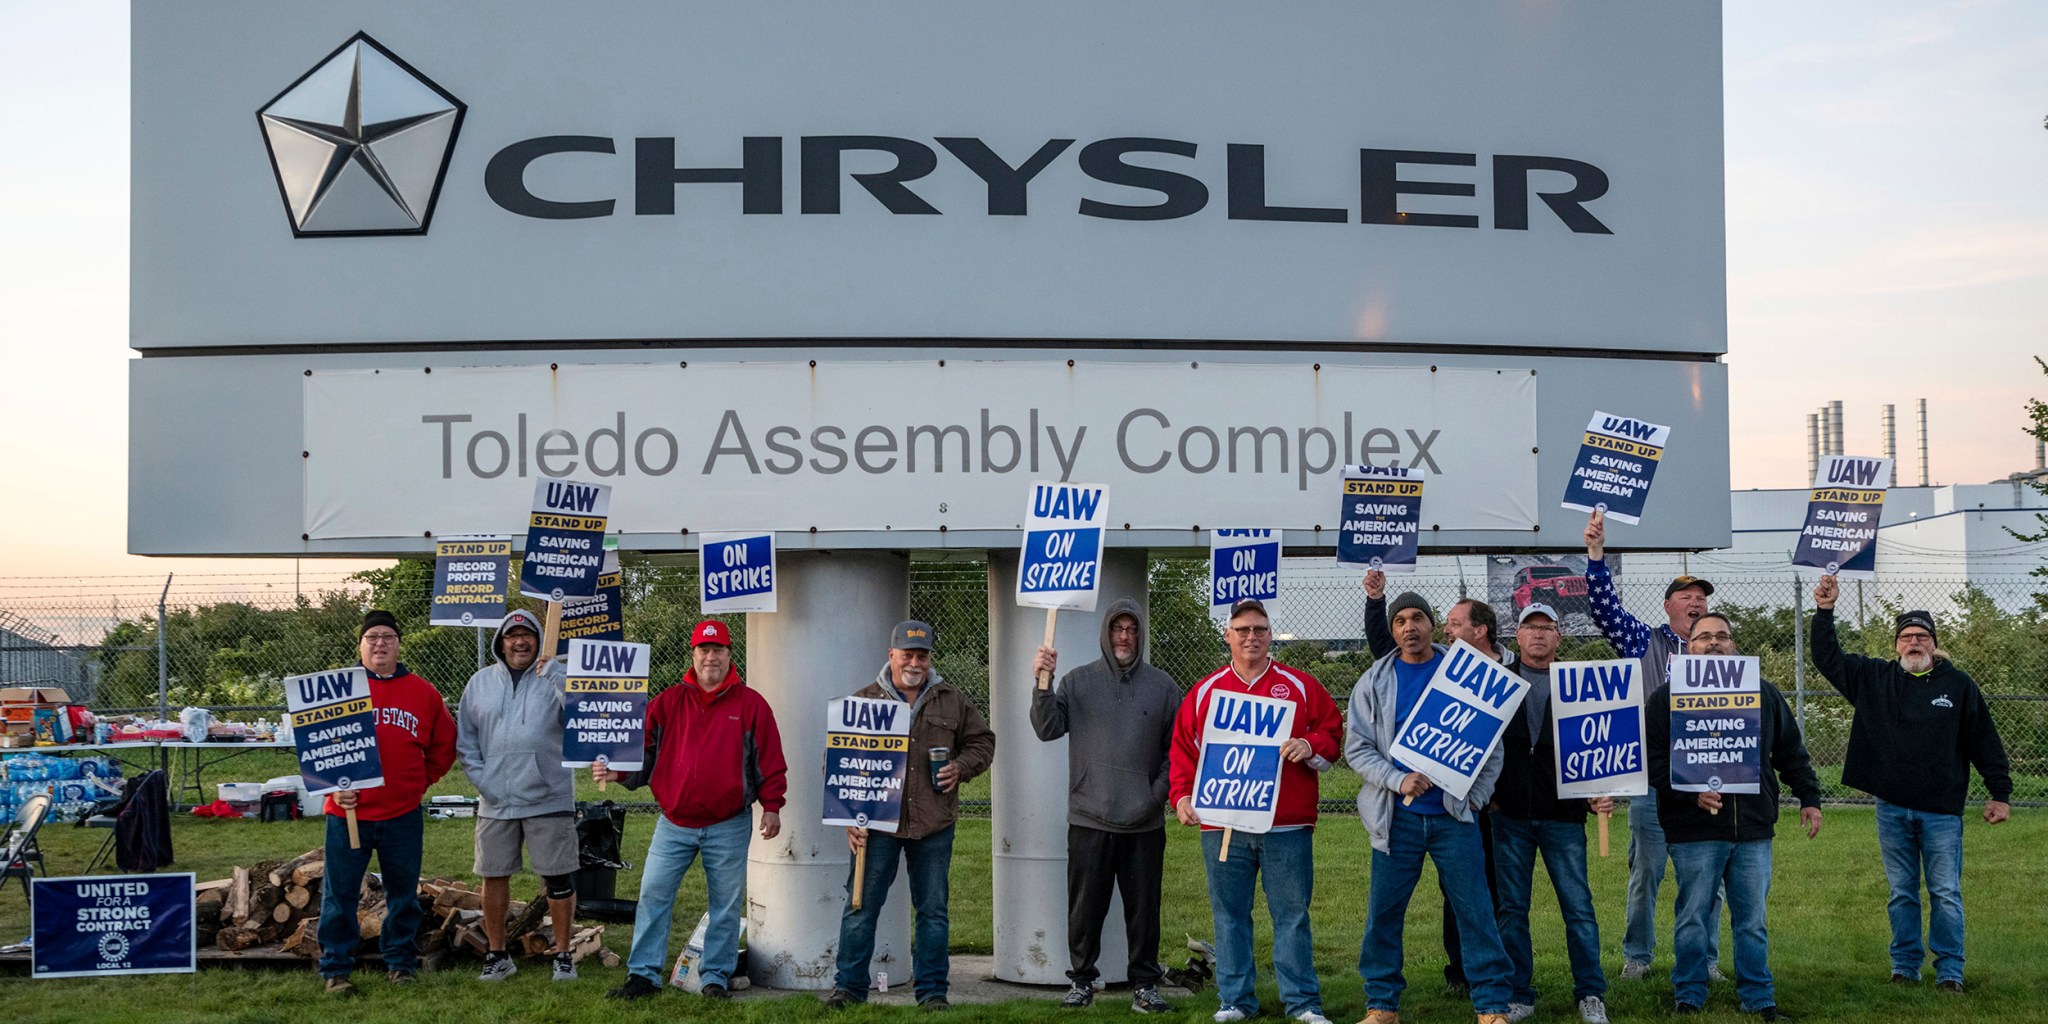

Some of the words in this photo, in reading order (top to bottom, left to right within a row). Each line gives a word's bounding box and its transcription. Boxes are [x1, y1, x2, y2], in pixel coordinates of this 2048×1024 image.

[484, 135, 1615, 235] CHRYSLER
[1602, 417, 1658, 441] UAW
[422, 411, 679, 479] Toledo
[701, 407, 1087, 481] Assembly
[1116, 408, 1442, 490] Complex
[1588, 436, 1634, 452] STAND
[1638, 447, 1657, 457] UP
[1590, 454, 1642, 474] SAVING
[1574, 466, 1649, 490] AMERICAN
[1828, 459, 1882, 486] UAW
[1348, 483, 1395, 494] STAND
[1400, 484, 1418, 494] UP
[1582, 480, 1634, 498] DREAM
[1814, 490, 1858, 502] STAND
[1862, 493, 1880, 502] UP
[546, 482, 600, 513] UAW
[1034, 485, 1102, 521] UAW
[1354, 503, 1407, 516] SAVING
[1816, 510, 1868, 523] SAVING
[534, 516, 580, 528] STAND
[584, 520, 603, 530] UP
[1342, 520, 1416, 533] AMERICAN
[1353, 534, 1403, 545] DREAM
[1803, 525, 1875, 539] AMERICAN
[441, 545, 485, 554] STAND
[489, 544, 506, 553] UP
[539, 536, 591, 549] SAVING
[1045, 531, 1076, 559] ON
[1811, 538, 1861, 552] DREAM
[526, 552, 599, 567] AMERICAN
[723, 543, 748, 568] ON
[1232, 549, 1256, 572] ON
[448, 562, 496, 572] RECORD
[536, 565, 586, 578] DREAM
[1024, 561, 1096, 589] STRIKE
[447, 572, 496, 582] PROFITS
[598, 577, 616, 587] UP
[707, 564, 771, 595] STRIKE
[446, 584, 494, 594] RECORD
[1216, 571, 1276, 600] STRIKE
[434, 594, 504, 604] CONTRACTS
[560, 602, 609, 618] PROFITS
[561, 614, 609, 629] RECORD
[558, 622, 620, 640] ONTRACTS
[581, 644, 638, 673] UAW
[1445, 647, 1520, 710] UAW
[1686, 659, 1746, 688] UAW
[299, 672, 353, 704] UAW
[571, 680, 619, 690] STAND
[624, 681, 643, 690] UP
[1558, 664, 1632, 703] UAW
[578, 701, 633, 712] SAVING
[1676, 697, 1729, 708] STAND
[1734, 696, 1755, 706] UP
[296, 706, 344, 725] STAND
[348, 701, 367, 713] UP
[842, 700, 898, 731] UAW
[1213, 696, 1287, 738] UAW
[1439, 702, 1477, 733] ON
[382, 708, 418, 738] STATE
[566, 718, 643, 730] AMERICAN
[1580, 713, 1612, 745] ON
[1686, 718, 1745, 732] SAVING
[308, 722, 362, 743] SAVING
[578, 732, 630, 743] DREAM
[301, 736, 376, 762] AMERICAN
[832, 736, 879, 748] STAND
[884, 738, 903, 749] UP
[1406, 722, 1484, 771] STRIKE
[1674, 736, 1757, 750] AMERICAN
[314, 751, 366, 772] DREAM
[839, 757, 893, 771] SAVING
[1223, 746, 1255, 775] ON
[1565, 741, 1640, 780] STRIKE
[1687, 751, 1743, 764] DREAM
[827, 774, 901, 790] AMERICAN
[838, 788, 888, 802] DREAM
[1200, 778, 1274, 808] STRIKE
[76, 882, 149, 897] UNITED
[96, 897, 122, 906] FOR
[122, 897, 131, 906] A
[77, 906, 150, 921] STRONG
[76, 920, 152, 932] CONTRACT
